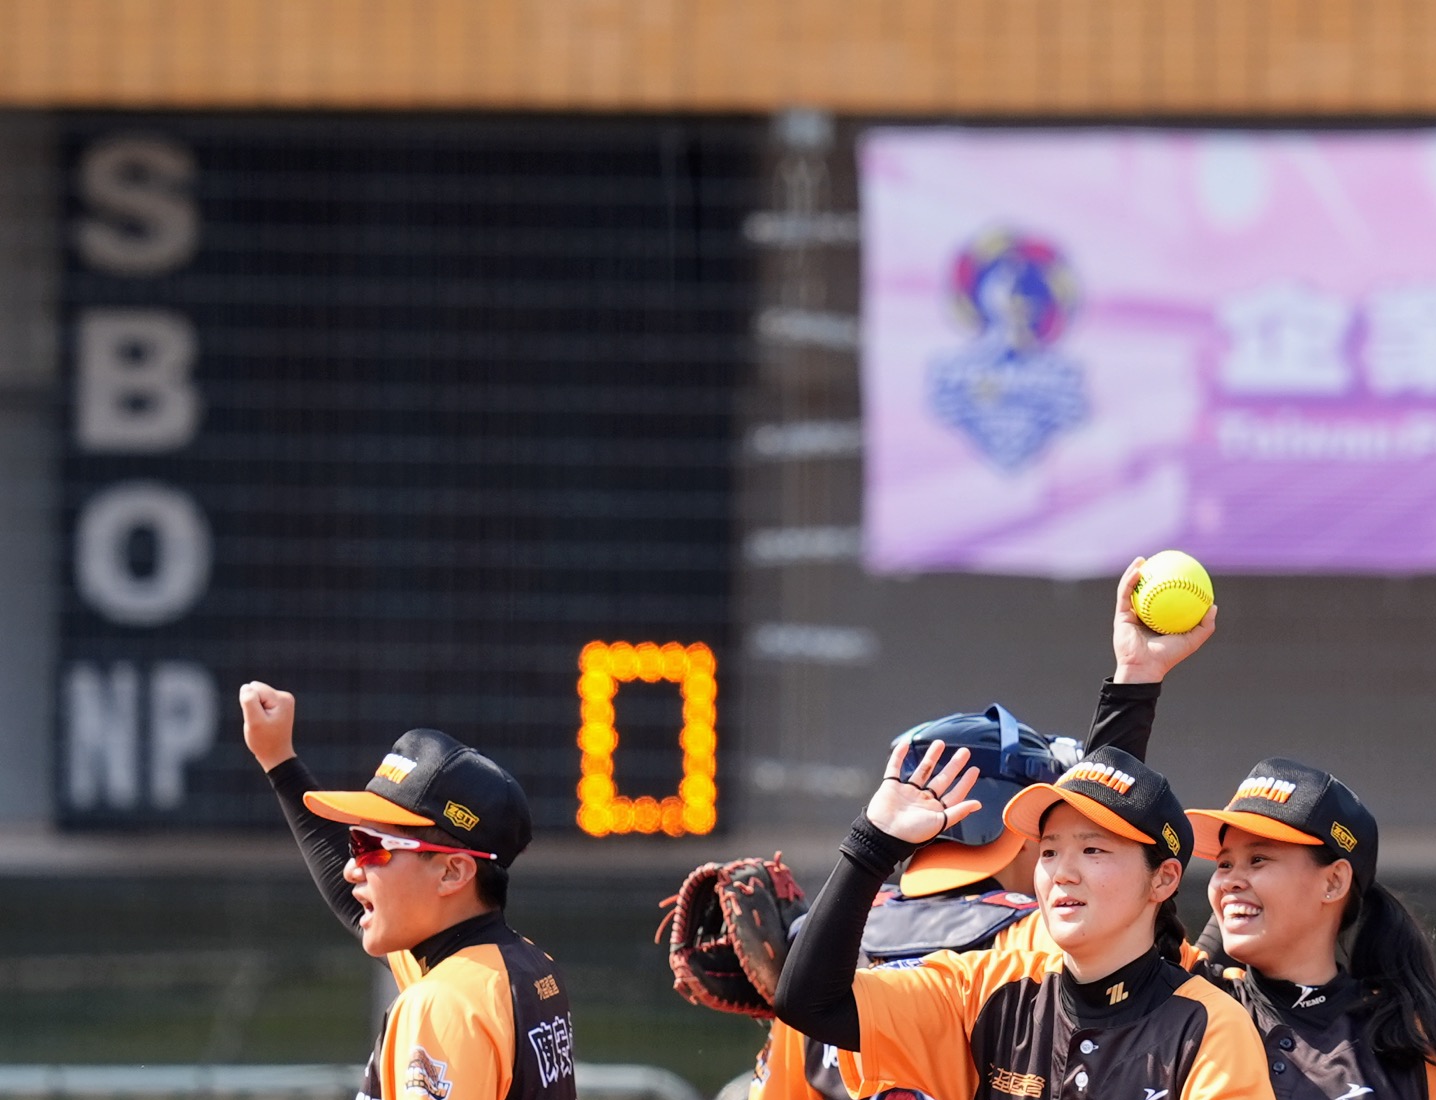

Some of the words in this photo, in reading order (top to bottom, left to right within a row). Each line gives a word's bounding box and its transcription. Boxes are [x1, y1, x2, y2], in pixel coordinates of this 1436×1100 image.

[79, 133, 200, 278] S
[78, 307, 200, 451] B
[76, 482, 212, 627] O
[66, 660, 216, 808] NP
[576, 640, 718, 838] 0
[446, 805, 476, 826] ZETT
[1333, 826, 1357, 849] ZETT
